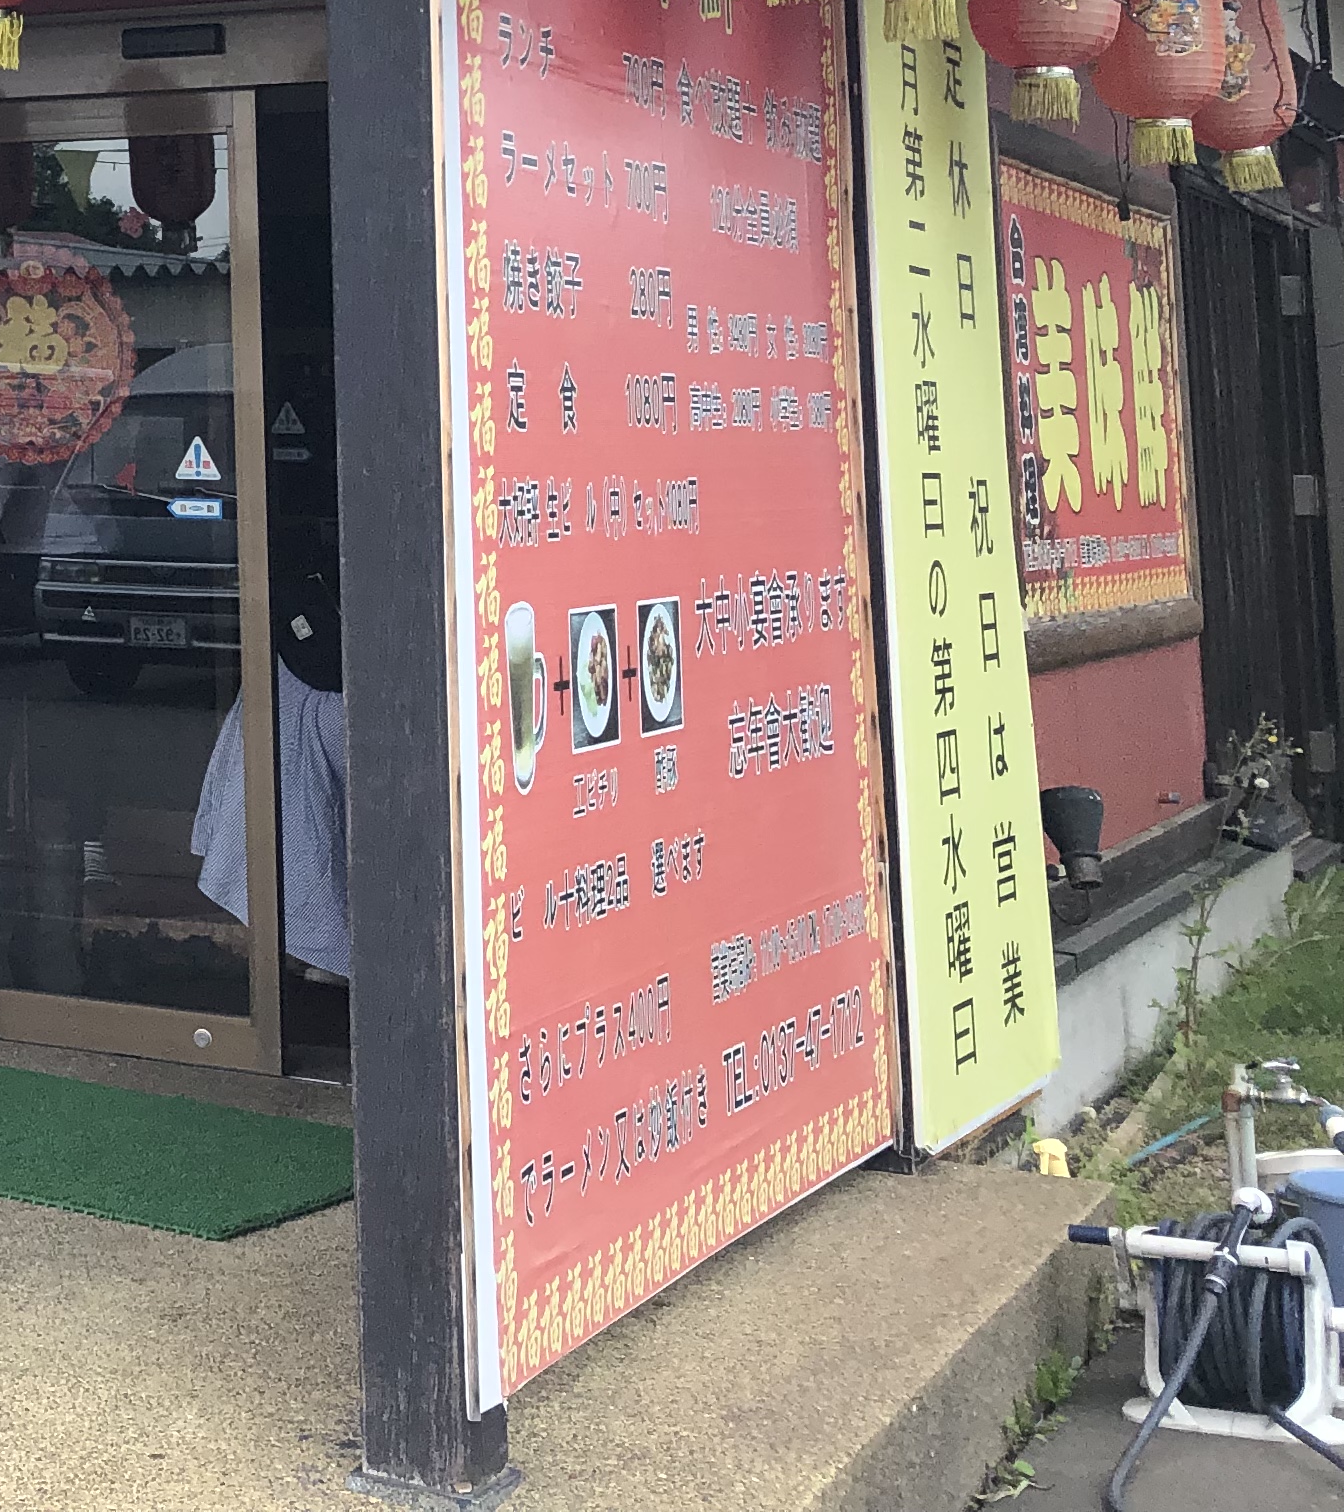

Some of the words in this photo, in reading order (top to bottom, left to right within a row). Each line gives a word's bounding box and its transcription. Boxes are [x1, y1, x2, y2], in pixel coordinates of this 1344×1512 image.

[498, 12, 555, 80] ランチ
[624, 159, 670, 224] 700円
[502, 240, 583, 320] 焼き餃子
[629, 265, 674, 329] 280円
[625, 372, 679, 434] 1080円
[1031, 255, 1169, 514] 美味鮮
[573, 767, 619, 818] エビチリ
[651, 828, 706, 898] 選べます
